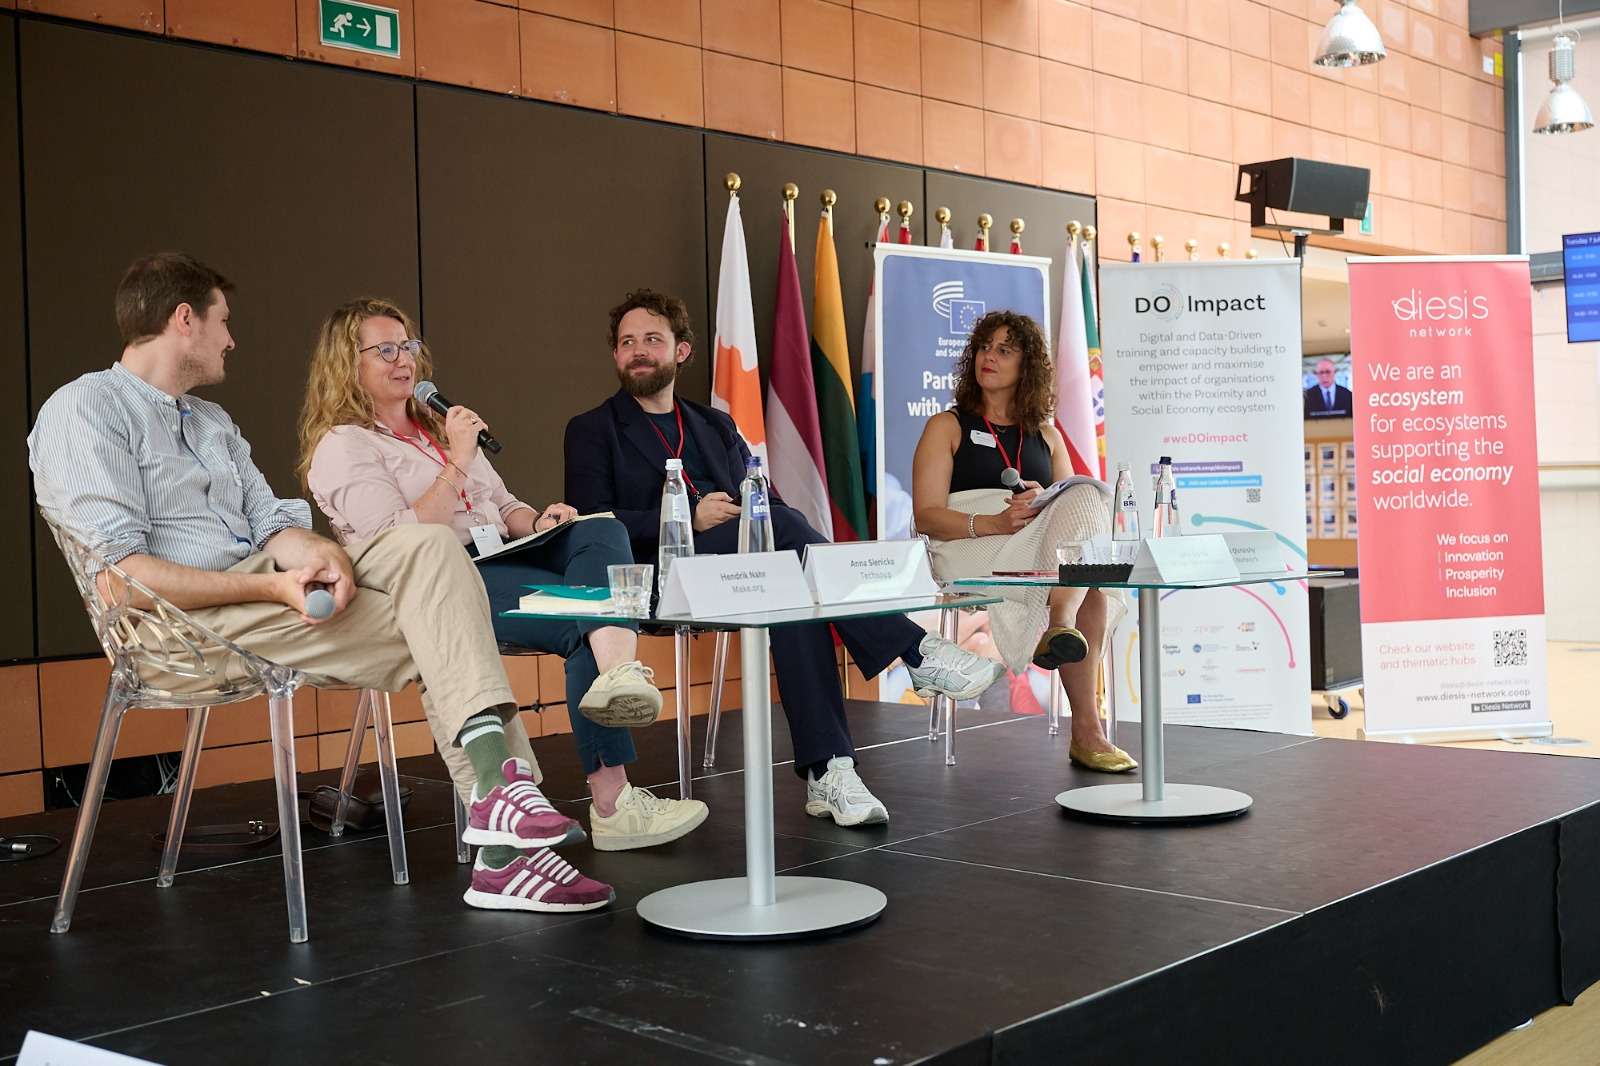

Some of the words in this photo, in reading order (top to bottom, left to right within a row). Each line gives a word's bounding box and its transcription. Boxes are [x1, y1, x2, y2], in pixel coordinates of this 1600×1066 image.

[1135, 296, 1171, 314] DO
[1188, 294, 1266, 316] Impact
[1392, 288, 1489, 320] diesis
[1140, 332, 1173, 344] Digital
[1176, 332, 1196, 342] and
[1200, 330, 1262, 341] Data-Driven
[1410, 326, 1472, 337] network
[936, 348, 948, 357] and
[949, 348, 964, 357] Soci
[1116, 348, 1157, 358] training
[1160, 347, 1180, 356] and
[1182, 346, 1226, 358] capacity
[1230, 345, 1272, 356] building
[1275, 345, 1286, 354] to
[1139, 362, 1188, 372] empower
[1192, 360, 1211, 370] and
[1214, 360, 1264, 369] maximise
[1368, 363, 1400, 380] We
[1406, 364, 1434, 380] are
[1440, 364, 1462, 379] an
[922, 371, 954, 390] Part
[1130, 376, 1148, 386] the
[1150, 376, 1188, 386] impact
[1190, 376, 1202, 385] of
[1204, 374, 1275, 386] organisations
[1138, 390, 1172, 400] within
[1174, 390, 1192, 399] the
[1194, 389, 1244, 400] Proximity
[1246, 388, 1267, 398] and
[1368, 389, 1464, 410] ecosystem
[907, 396, 941, 416] with
[1132, 405, 1164, 416] Social
[1166, 404, 1215, 415] Economy
[1217, 404, 1276, 415] ecosystem
[1370, 413, 1396, 432] for
[1402, 414, 1507, 436] ecosystems
[1163, 432, 1248, 444] #weDOimpact
[1372, 439, 1470, 462] supporting
[1474, 438, 1504, 455] the
[1372, 464, 1424, 484] social
[1430, 465, 1514, 485] economy
[1374, 490, 1472, 510] worldwide.
[1436, 534, 1456, 545] We
[1460, 533, 1490, 544] focus
[1494, 534, 1508, 543] on
[1445, 550, 1504, 562] Innovation
[1446, 568, 1504, 582] Prosperity
[1446, 586, 1496, 598] Inclusion
[1380, 644, 1410, 655] Check
[1415, 645, 1432, 654] our
[1435, 642, 1474, 652] website
[1380, 660, 1400, 670] and
[1402, 658, 1448, 669] thematic
[1451, 656, 1477, 665] hubs
[1416, 688, 1530, 702] www.diesis-network.coop
[1502, 702, 1529, 710] Network
